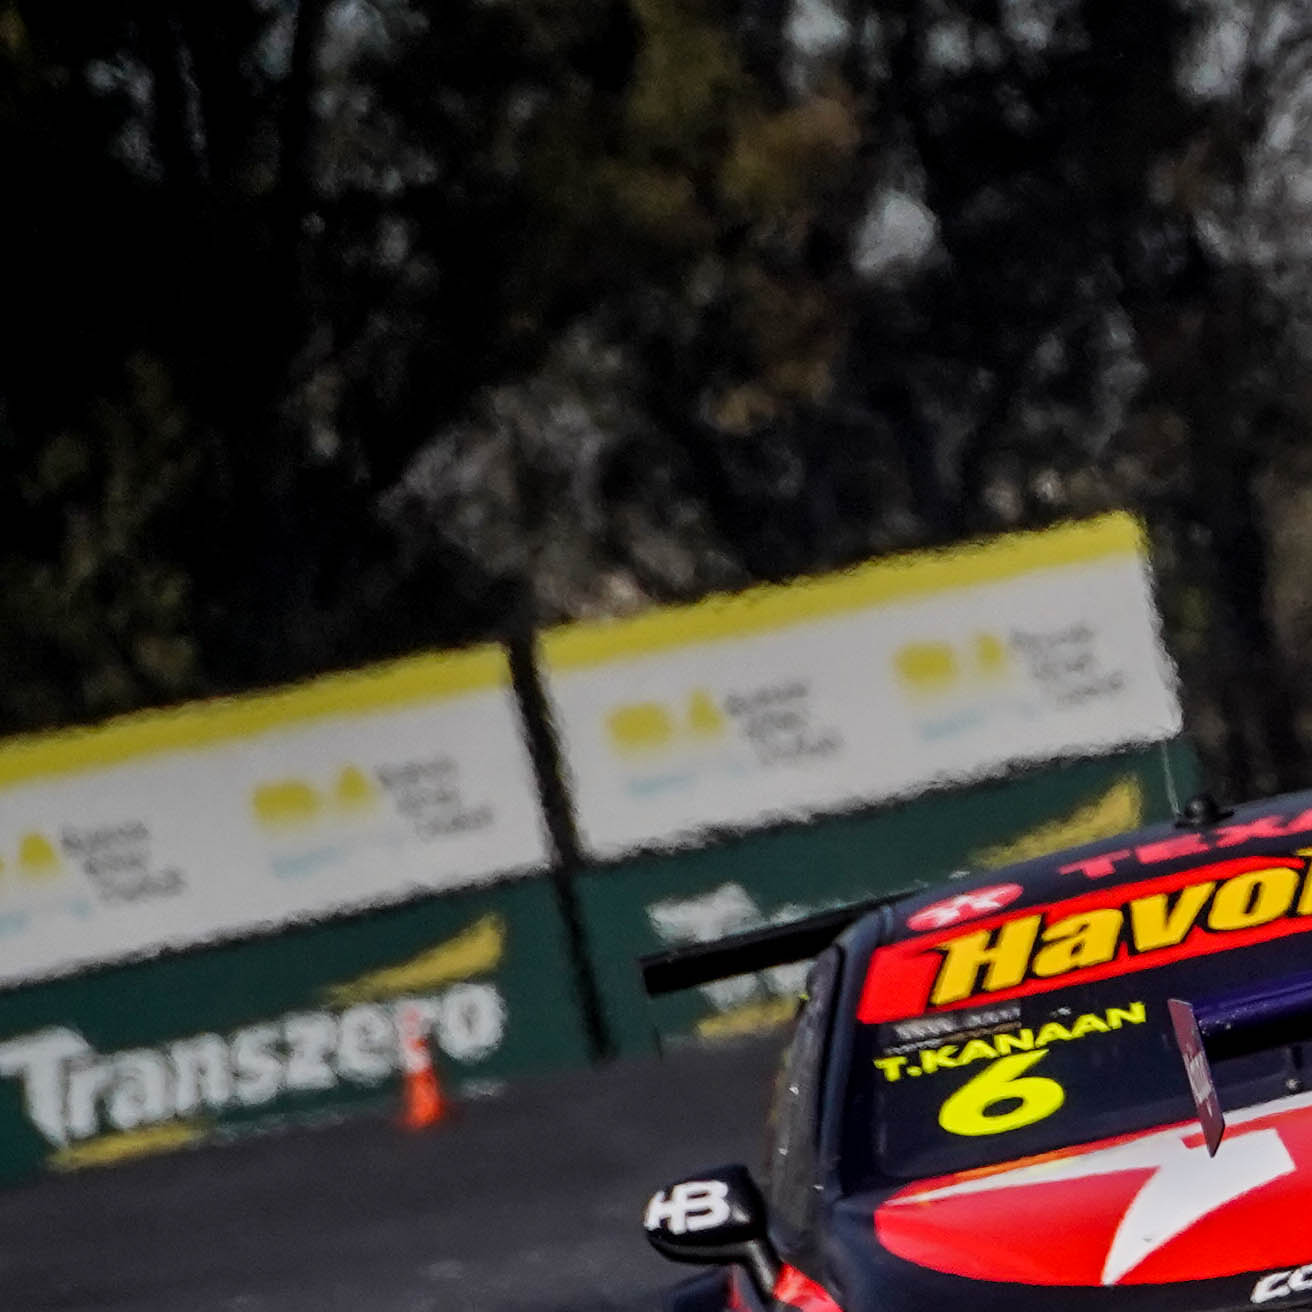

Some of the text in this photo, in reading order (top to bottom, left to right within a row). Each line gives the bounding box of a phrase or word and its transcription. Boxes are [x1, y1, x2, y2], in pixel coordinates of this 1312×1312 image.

[0, 982, 507, 1149] Transzero
[874, 1001, 1147, 1082] T.KANAAN
[938, 1049, 1066, 1137] 6
